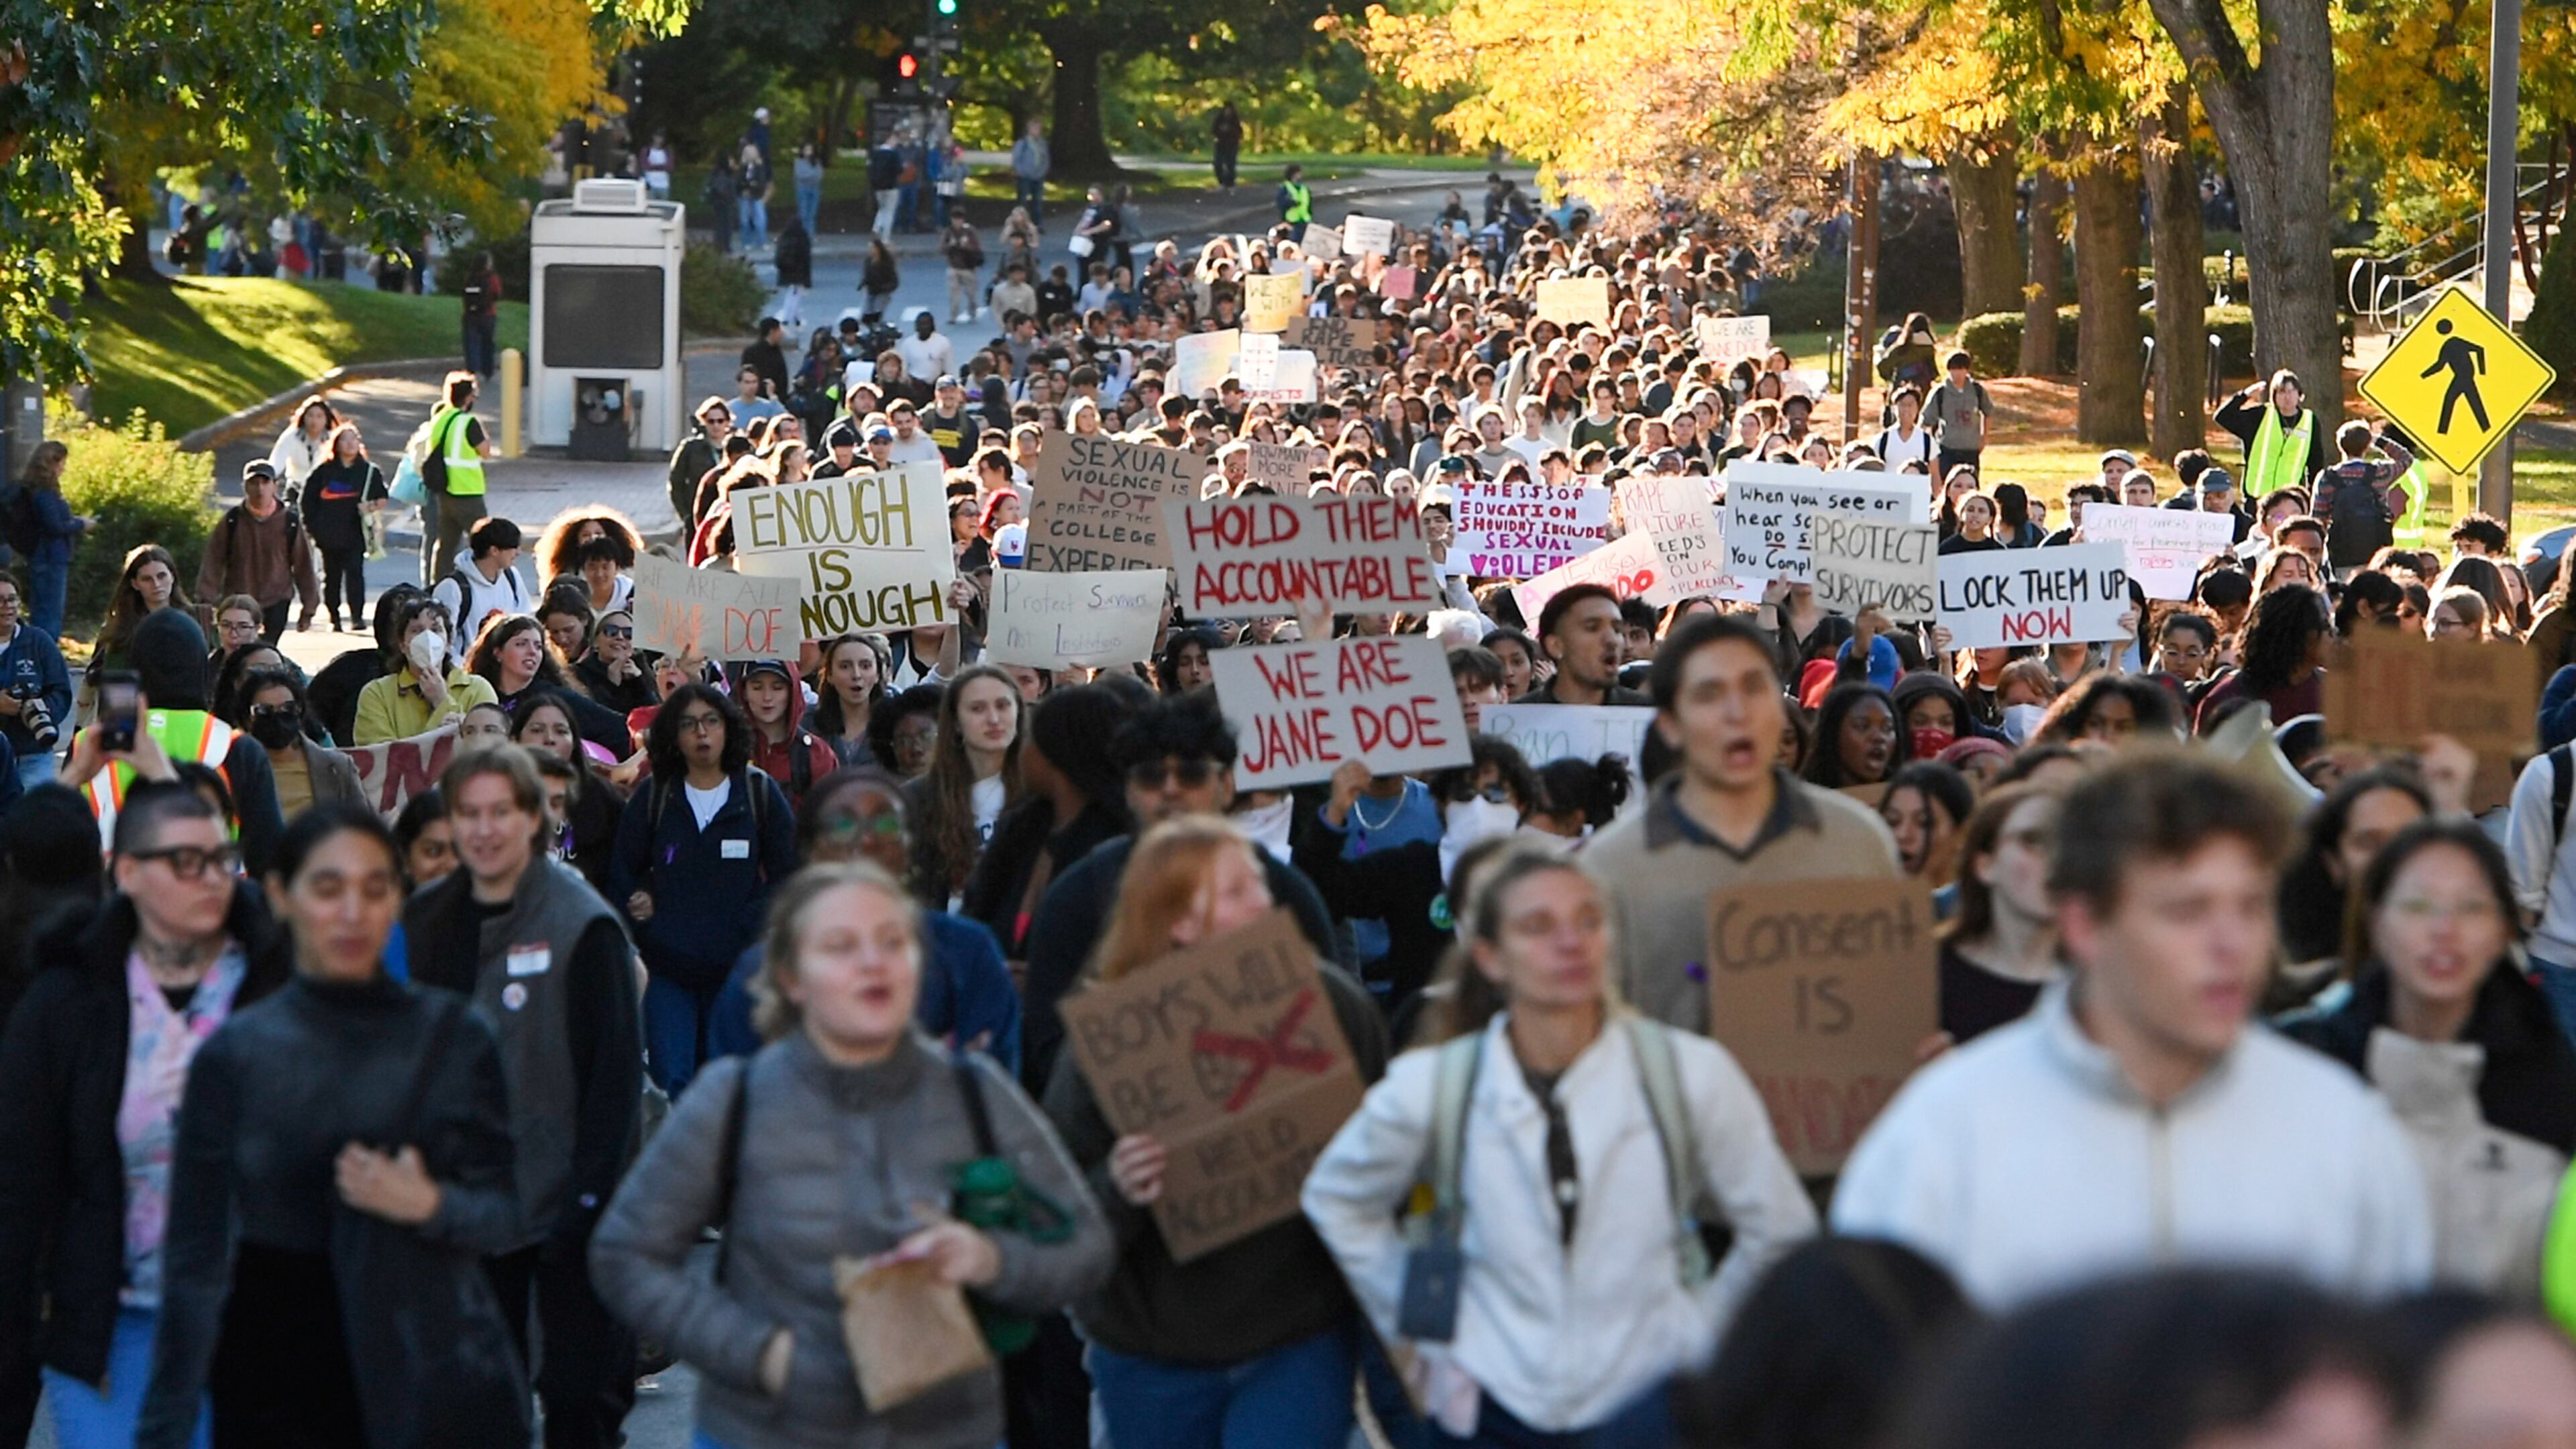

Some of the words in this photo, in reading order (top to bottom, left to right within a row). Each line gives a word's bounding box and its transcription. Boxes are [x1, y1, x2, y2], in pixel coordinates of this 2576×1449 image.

[1301, 328, 1354, 347] RAPE
[1309, 317, 1347, 332] END
[1711, 322, 1730, 337] WE
[1735, 320, 1756, 336] ARE
[1068, 438, 1191, 480] SEXUAL
[1251, 443, 1276, 458] HOW
[1278, 447, 1309, 463] MANY
[1258, 459, 1295, 478] MORE
[1061, 467, 1163, 492] VIOLENCE
[1171, 484, 1189, 496] IS
[1458, 483, 1512, 498] THE
[747, 473, 914, 548] ENOUGH
[1035, 500, 1046, 510] A
[1056, 502, 1095, 515] PART
[1101, 508, 1121, 519] OF
[1126, 511, 1153, 525] THE
[1079, 486, 1156, 513] NOT
[1460, 501, 1576, 520] EDUCATION
[1622, 481, 1670, 514] RAPE
[1739, 486, 1784, 504] When
[1790, 492, 1819, 508] you
[1828, 494, 1866, 511] see
[1874, 498, 1899, 511] or
[1185, 503, 1301, 552] HOLD
[1313, 498, 1422, 544] THEM
[1735, 506, 1782, 527] hear
[1050, 519, 1157, 547] COLLEGE
[1485, 532, 1572, 550] SEXUAL
[1654, 535, 1707, 553] EEDS
[1814, 515, 1937, 566] PROTECT
[808, 548, 853, 594] IS
[1026, 542, 1169, 572] EXPERIE
[1666, 551, 1690, 564] ON
[1670, 559, 1717, 578] OUR
[1731, 546, 1757, 567] You
[1766, 547, 1811, 576] Compl
[641, 562, 663, 588] WE
[685, 573, 724, 602] ARE
[734, 578, 784, 604] ALL
[1004, 573, 1073, 613] Protect
[1193, 554, 1432, 611] ACCOUNTABLE
[1668, 574, 1735, 594] PLACENCY
[1817, 568, 1934, 613] SURVIVORS
[1940, 574, 2015, 612] LOCK
[2019, 568, 2088, 604] THEM
[2100, 569, 2127, 601] UP
[800, 580, 945, 639] NOUGH
[2002, 605, 2072, 642] NOW
[724, 606, 784, 655] DOE
[1253, 651, 1327, 703] WE
[1336, 641, 1413, 695] ARE
[1242, 708, 1342, 773] JANE
[1351, 696, 1447, 753] DOE
[1715, 898, 1917, 971] Consent
[1076, 977, 1210, 1065] BOYS
[1793, 976, 1856, 1036] IS
[1111, 1065, 1190, 1130] BE
